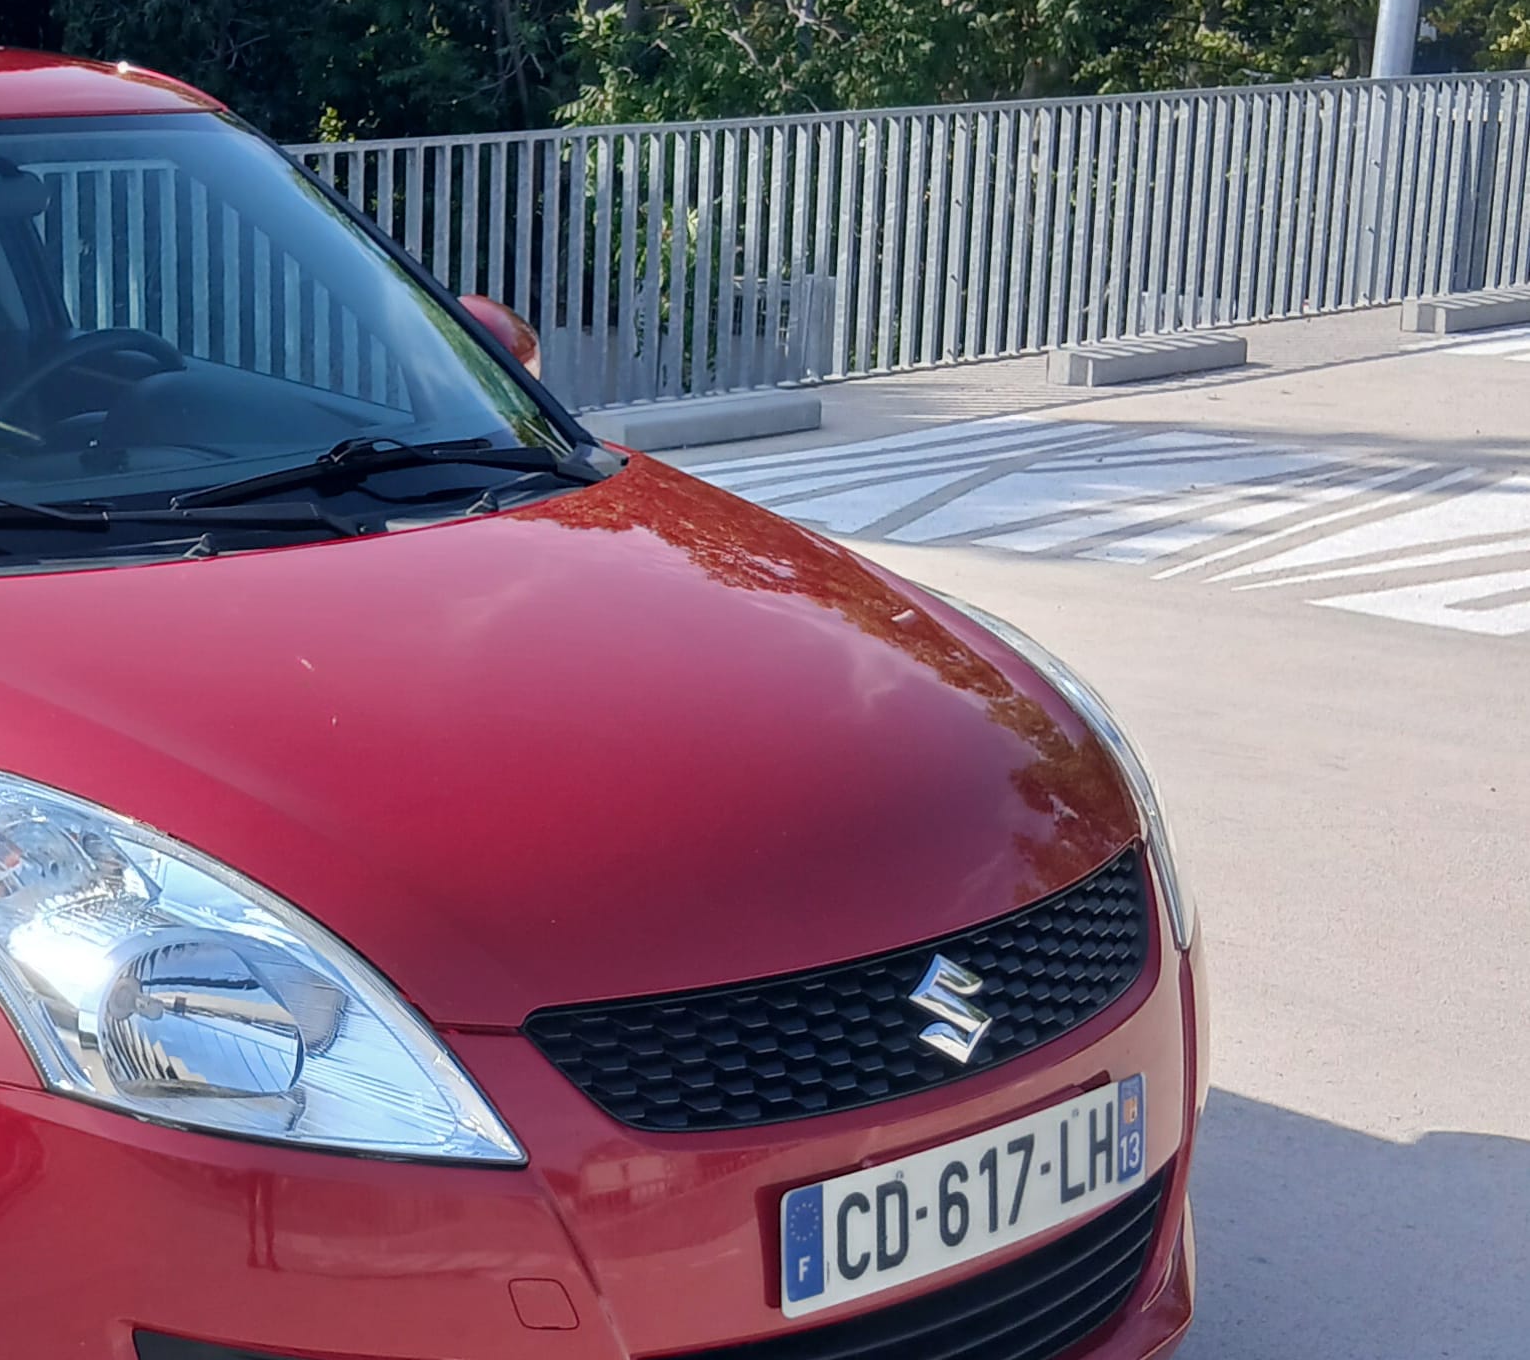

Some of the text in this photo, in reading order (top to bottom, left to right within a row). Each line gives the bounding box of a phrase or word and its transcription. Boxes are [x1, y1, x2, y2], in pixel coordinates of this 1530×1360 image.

[798, 1255, 811, 1282] F
[836, 1100, 1114, 1281] CD-617-LH
[1120, 1131, 1141, 1173] 13
